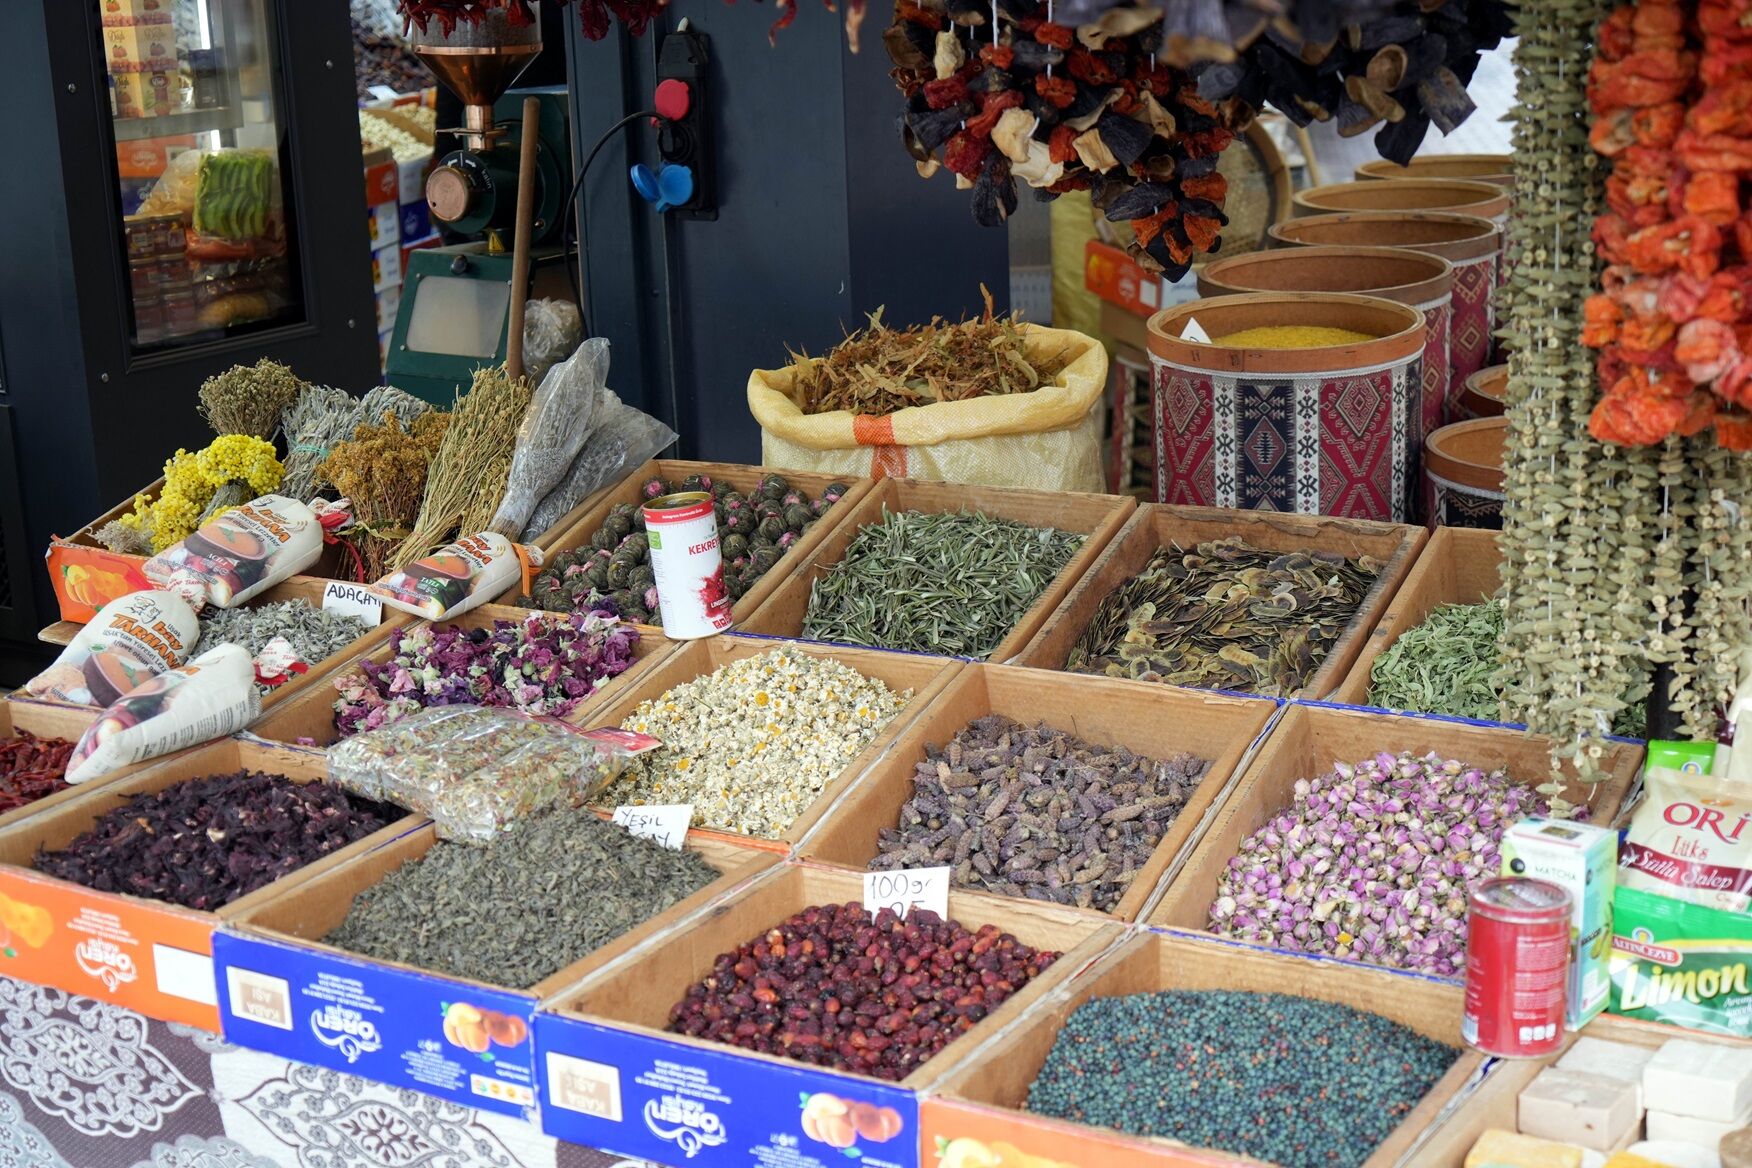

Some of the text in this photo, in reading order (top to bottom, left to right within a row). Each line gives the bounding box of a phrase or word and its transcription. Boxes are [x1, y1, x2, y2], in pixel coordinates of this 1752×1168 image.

[108, 612, 182, 670] TARHAN
[151, 620, 184, 651] bay
[154, 658, 168, 673] Lezz
[1680, 863, 1733, 890] Salep
[1620, 962, 1750, 1012] Limon
